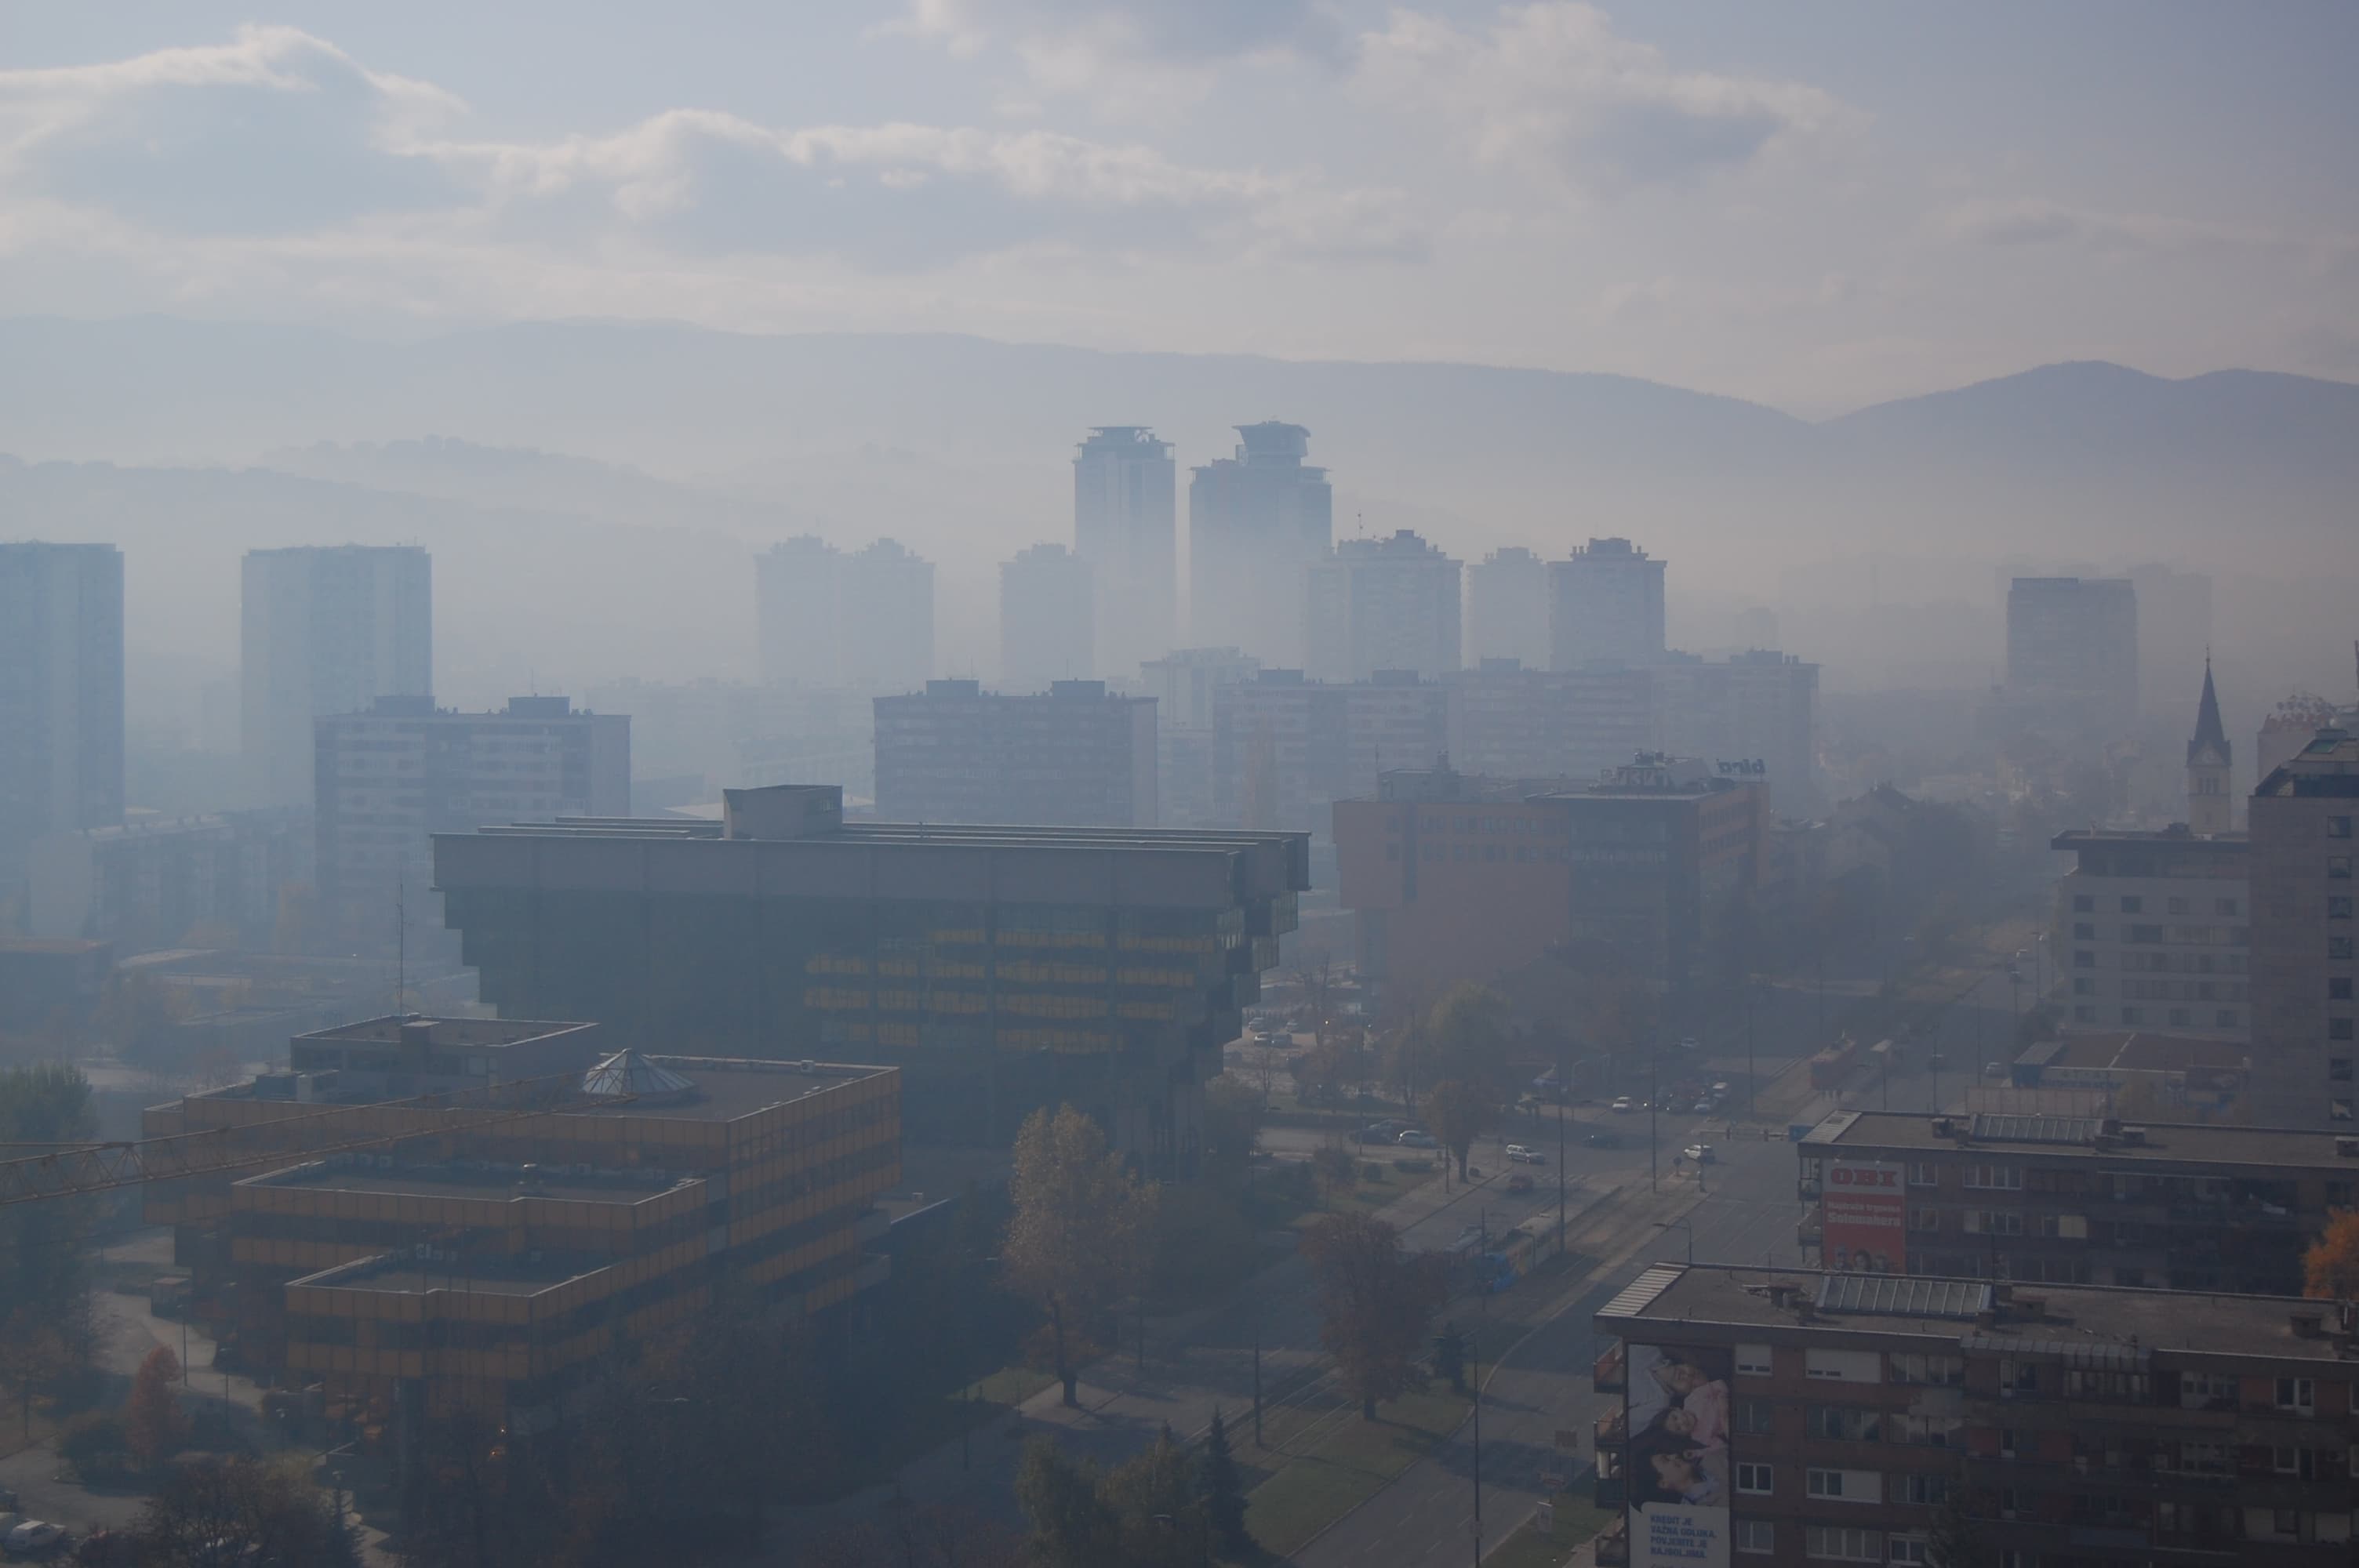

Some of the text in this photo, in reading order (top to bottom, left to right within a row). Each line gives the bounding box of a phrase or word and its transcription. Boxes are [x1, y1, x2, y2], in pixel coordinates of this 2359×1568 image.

[1831, 1168, 1897, 1186] OBI
[1650, 1515, 1692, 1526] KREDIT JE
[1698, 1539, 1707, 1548] JE
